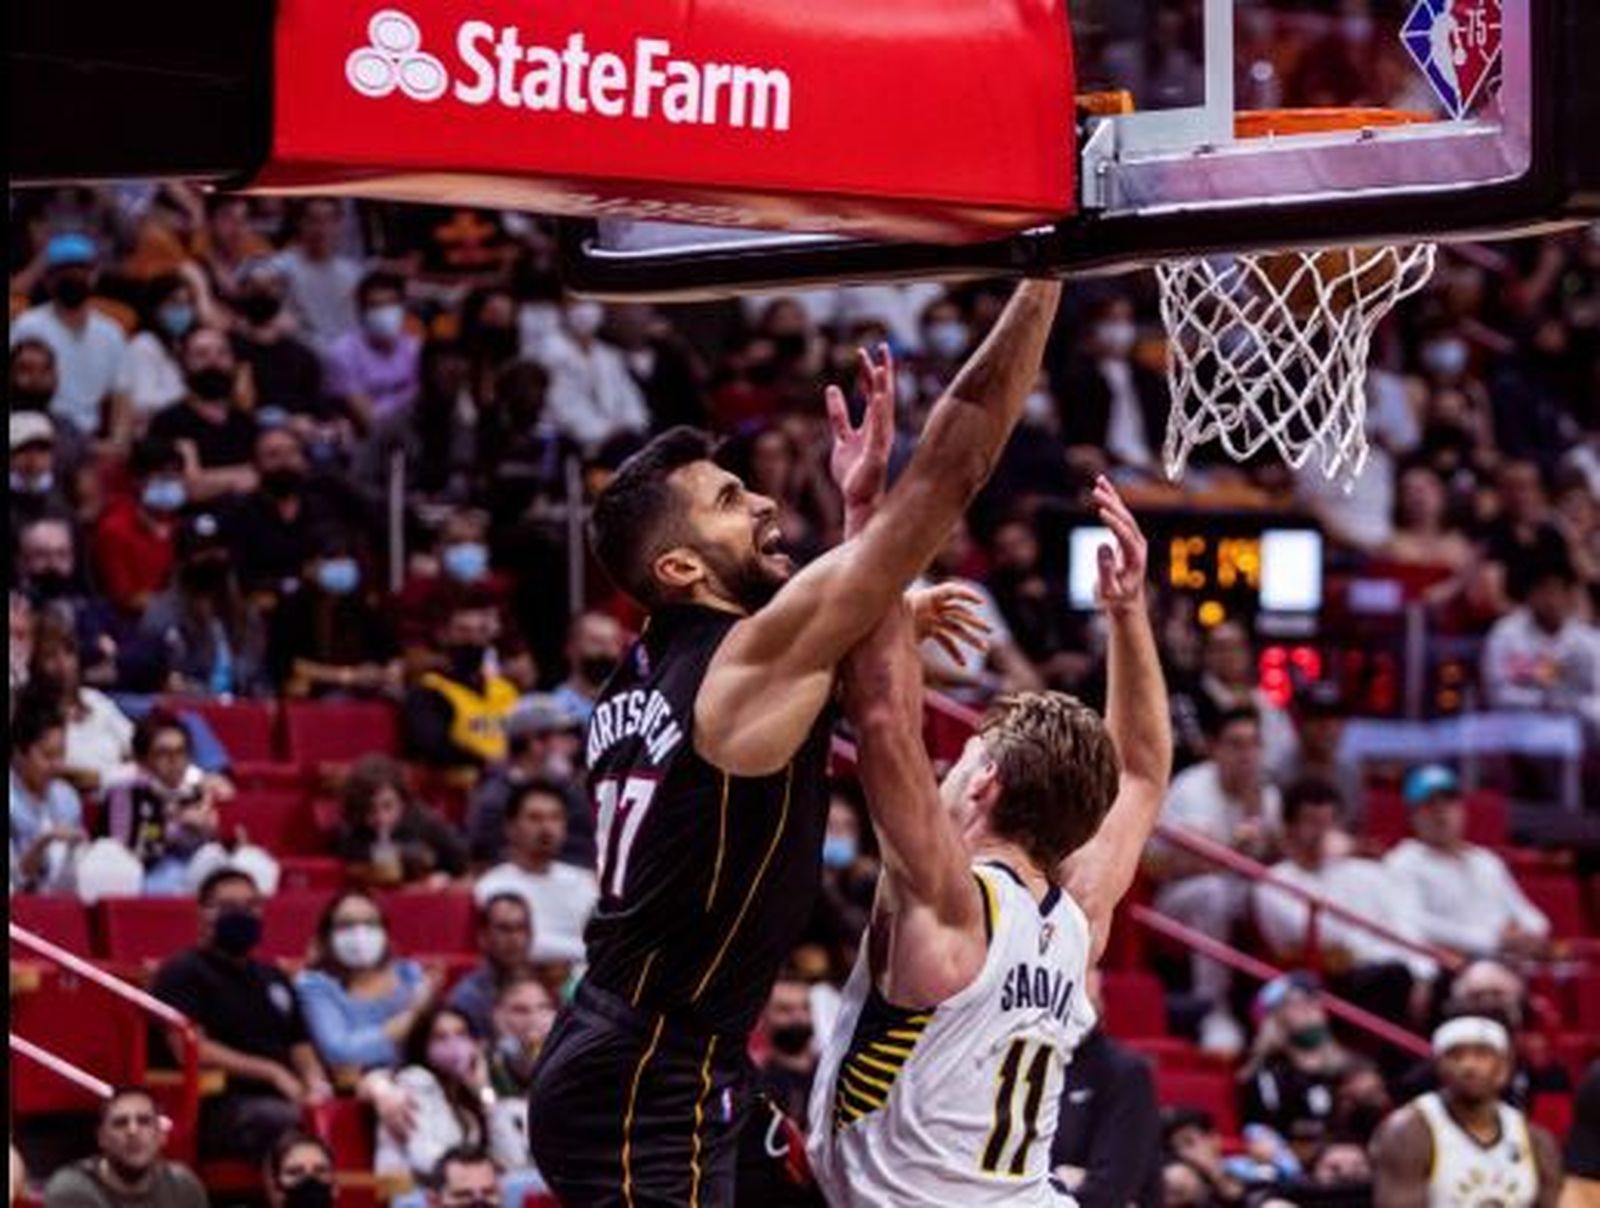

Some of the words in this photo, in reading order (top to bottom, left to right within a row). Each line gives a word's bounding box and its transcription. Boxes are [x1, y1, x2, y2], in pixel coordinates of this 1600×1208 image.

[1465, 8, 1487, 48] 75
[594, 777, 658, 897] 17
[979, 1037, 1055, 1176] 11
